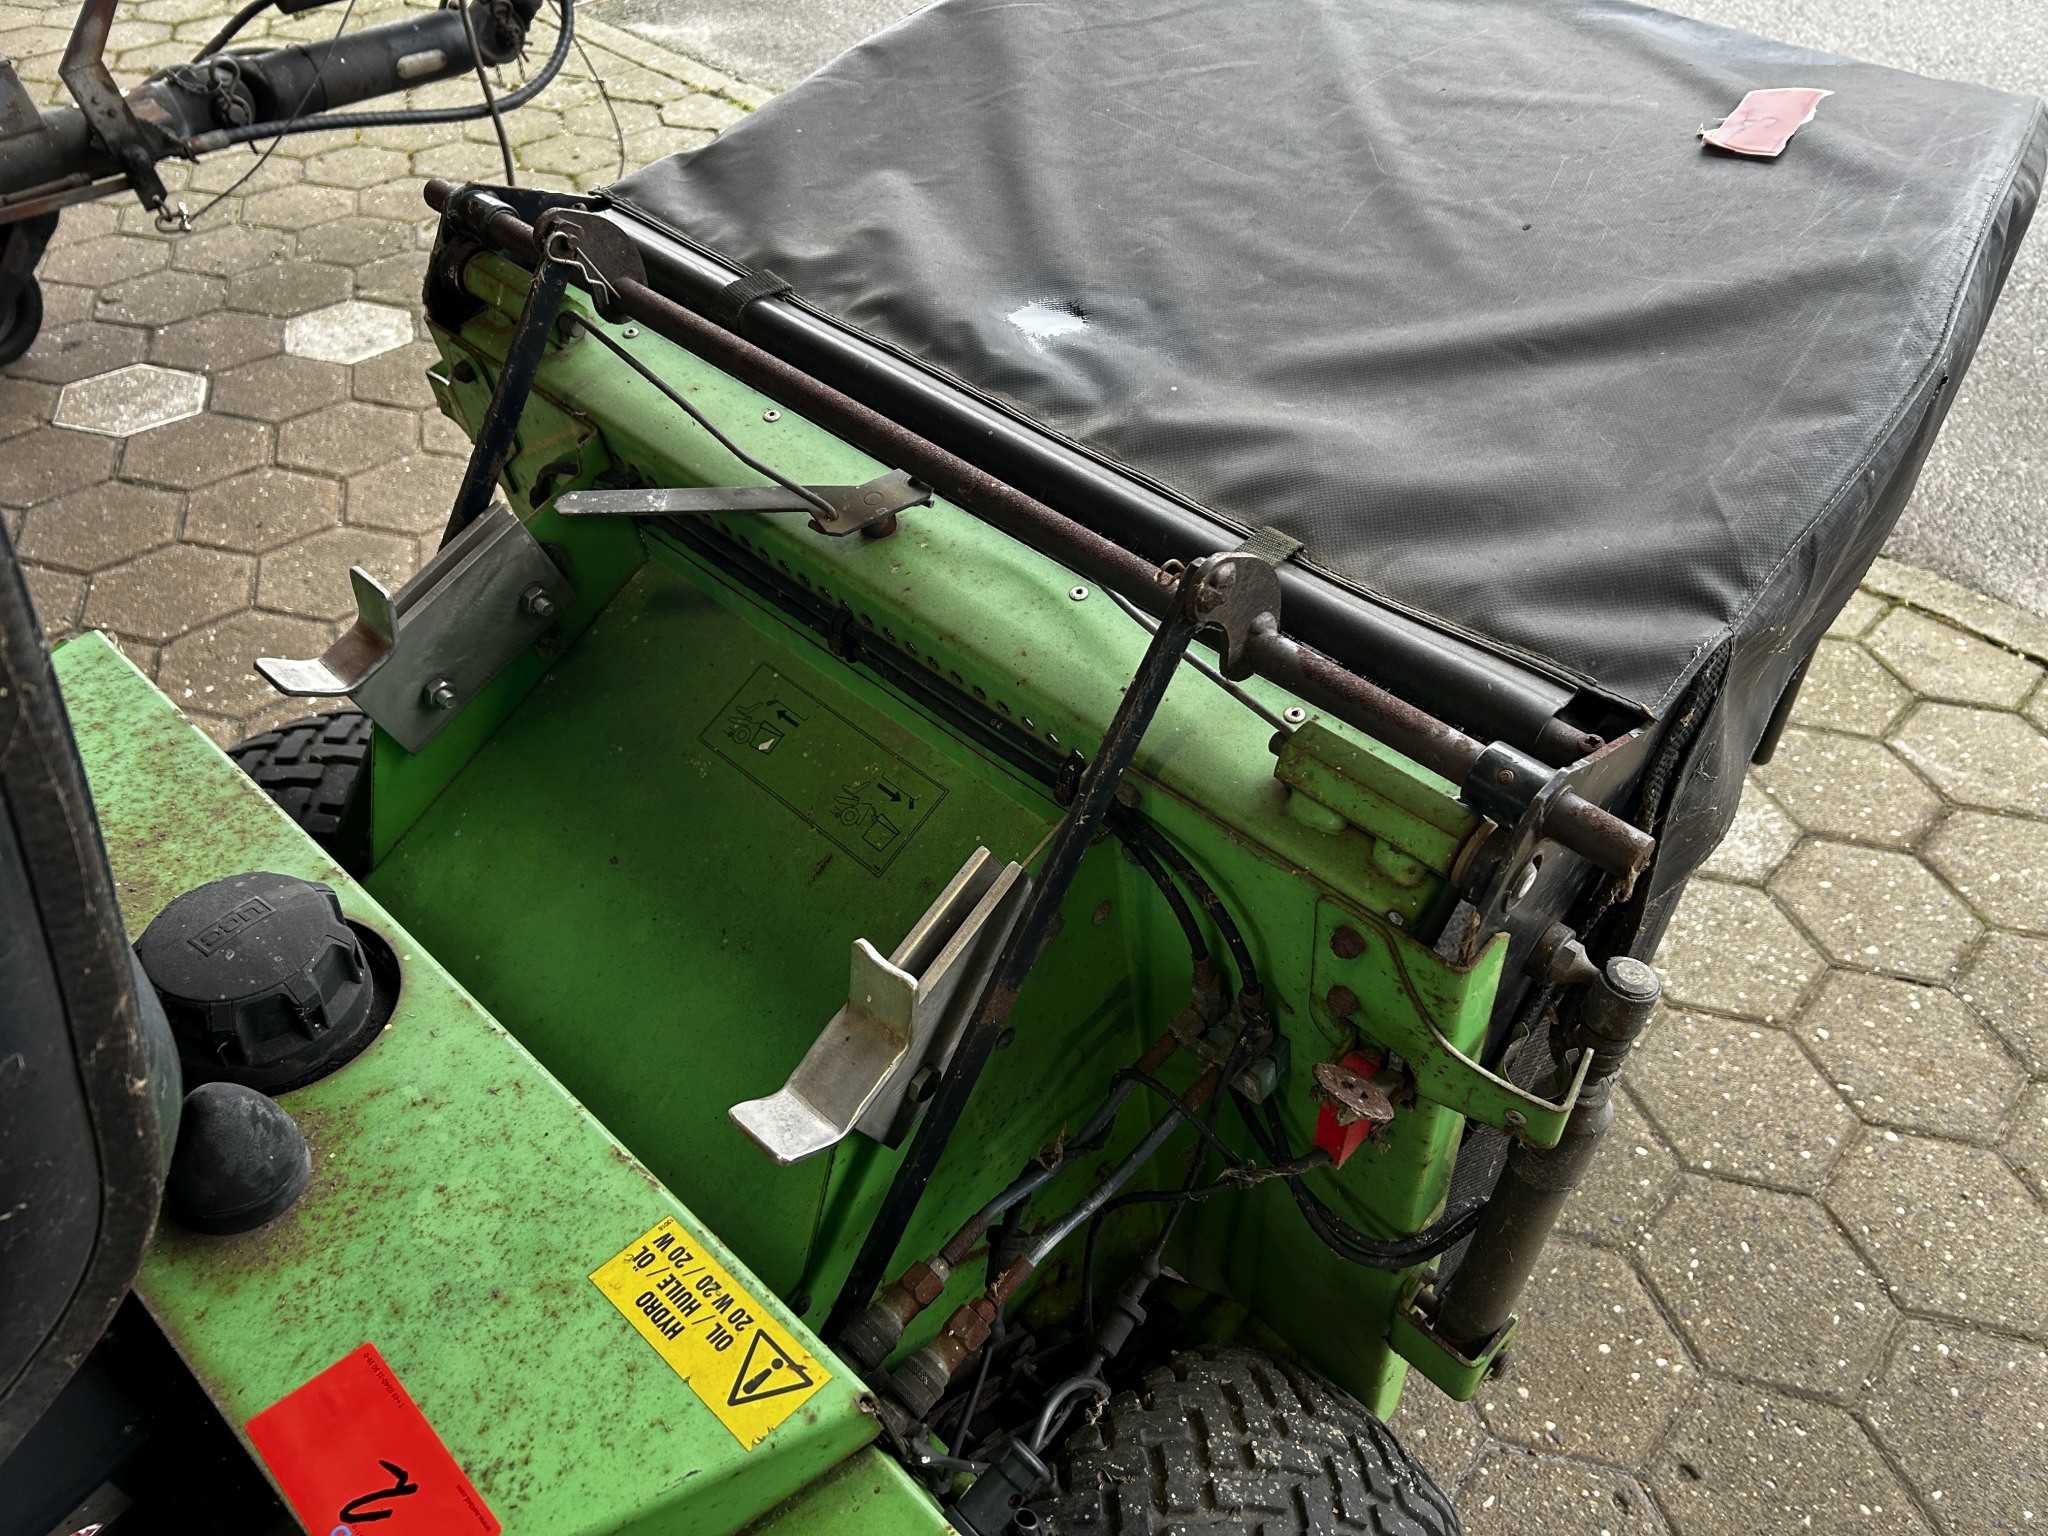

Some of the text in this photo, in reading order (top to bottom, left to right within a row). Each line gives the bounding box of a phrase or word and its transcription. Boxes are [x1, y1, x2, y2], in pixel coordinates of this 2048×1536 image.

[652, 1232, 676, 1253] W
[667, 1245, 694, 1269] 20
[682, 1266, 706, 1277] /
[632, 1245, 734, 1352] OIL / HUILE / ÖL
[635, 1290, 686, 1341] HYDRO
[727, 1307, 755, 1332] 20
